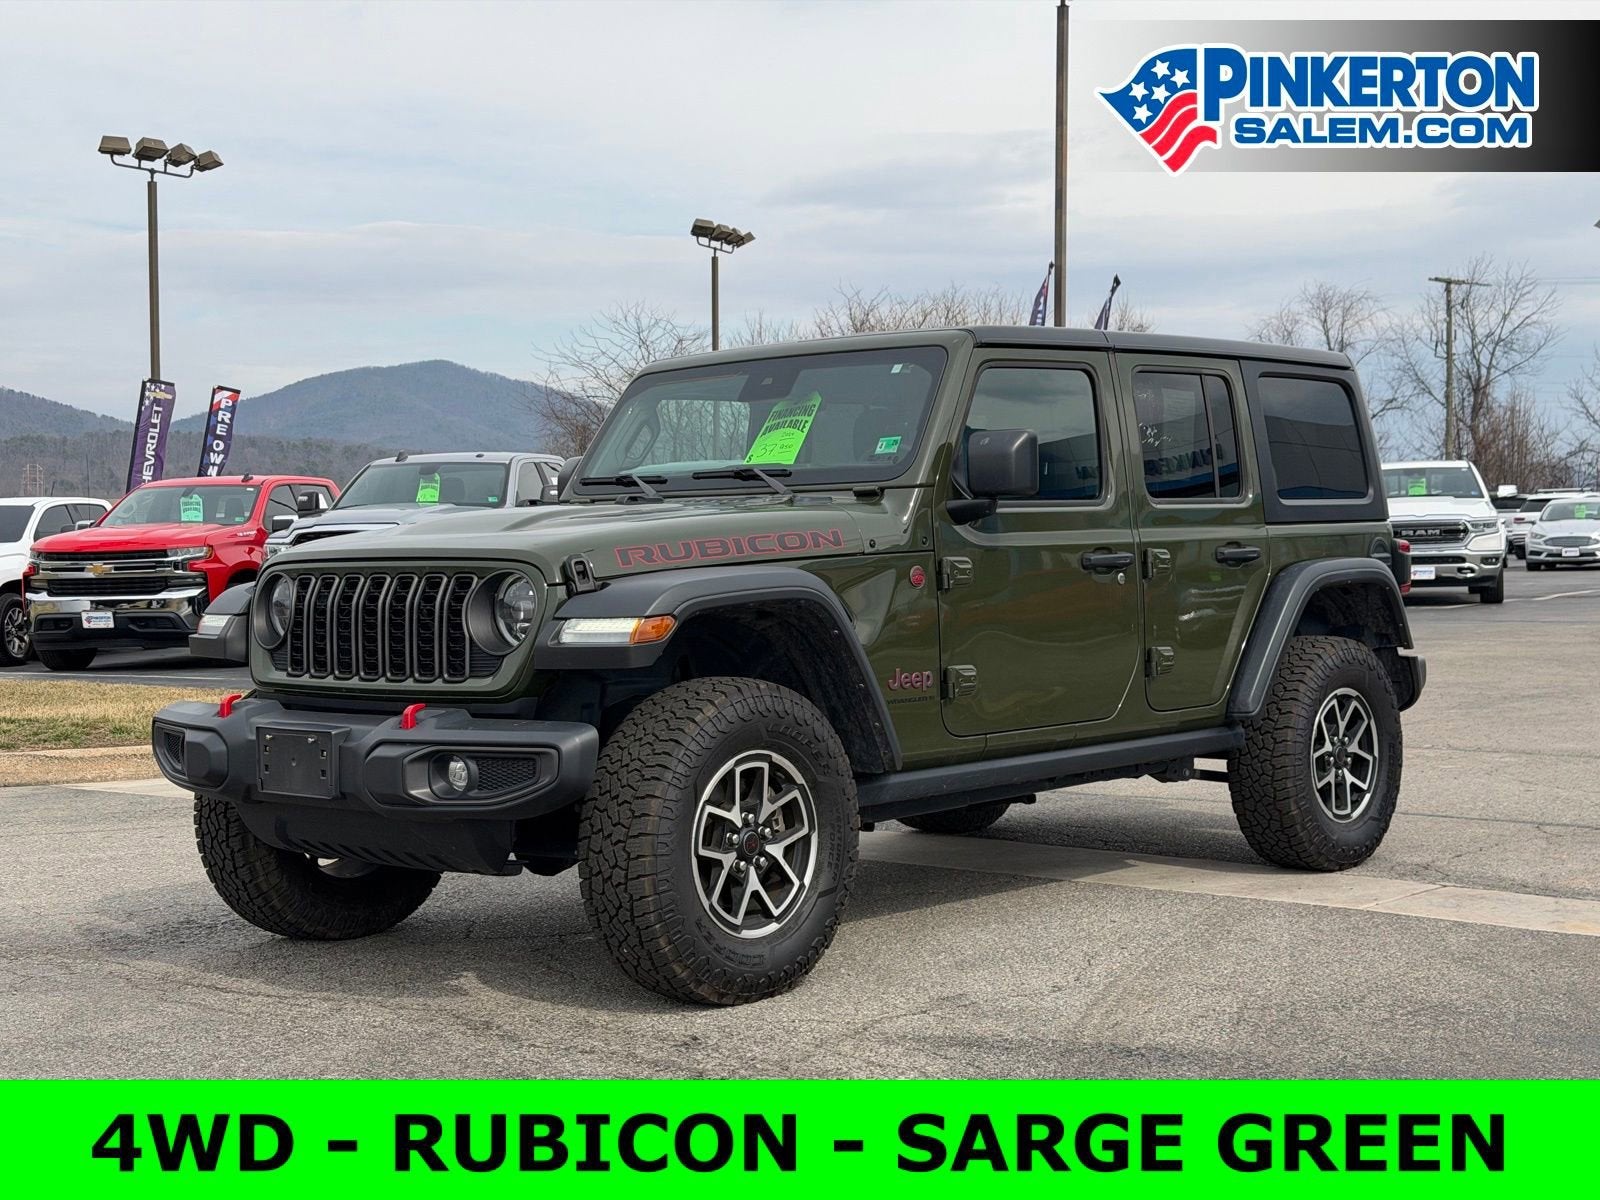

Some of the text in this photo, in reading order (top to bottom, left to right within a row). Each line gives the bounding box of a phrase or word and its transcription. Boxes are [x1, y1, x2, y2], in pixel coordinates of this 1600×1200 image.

[215, 398, 233, 435] PRE
[767, 404, 816, 424] FINANCING
[760, 418, 809, 437] AVAILABLE
[615, 529, 843, 568] RUBICON
[888, 667, 933, 692] Jeep
